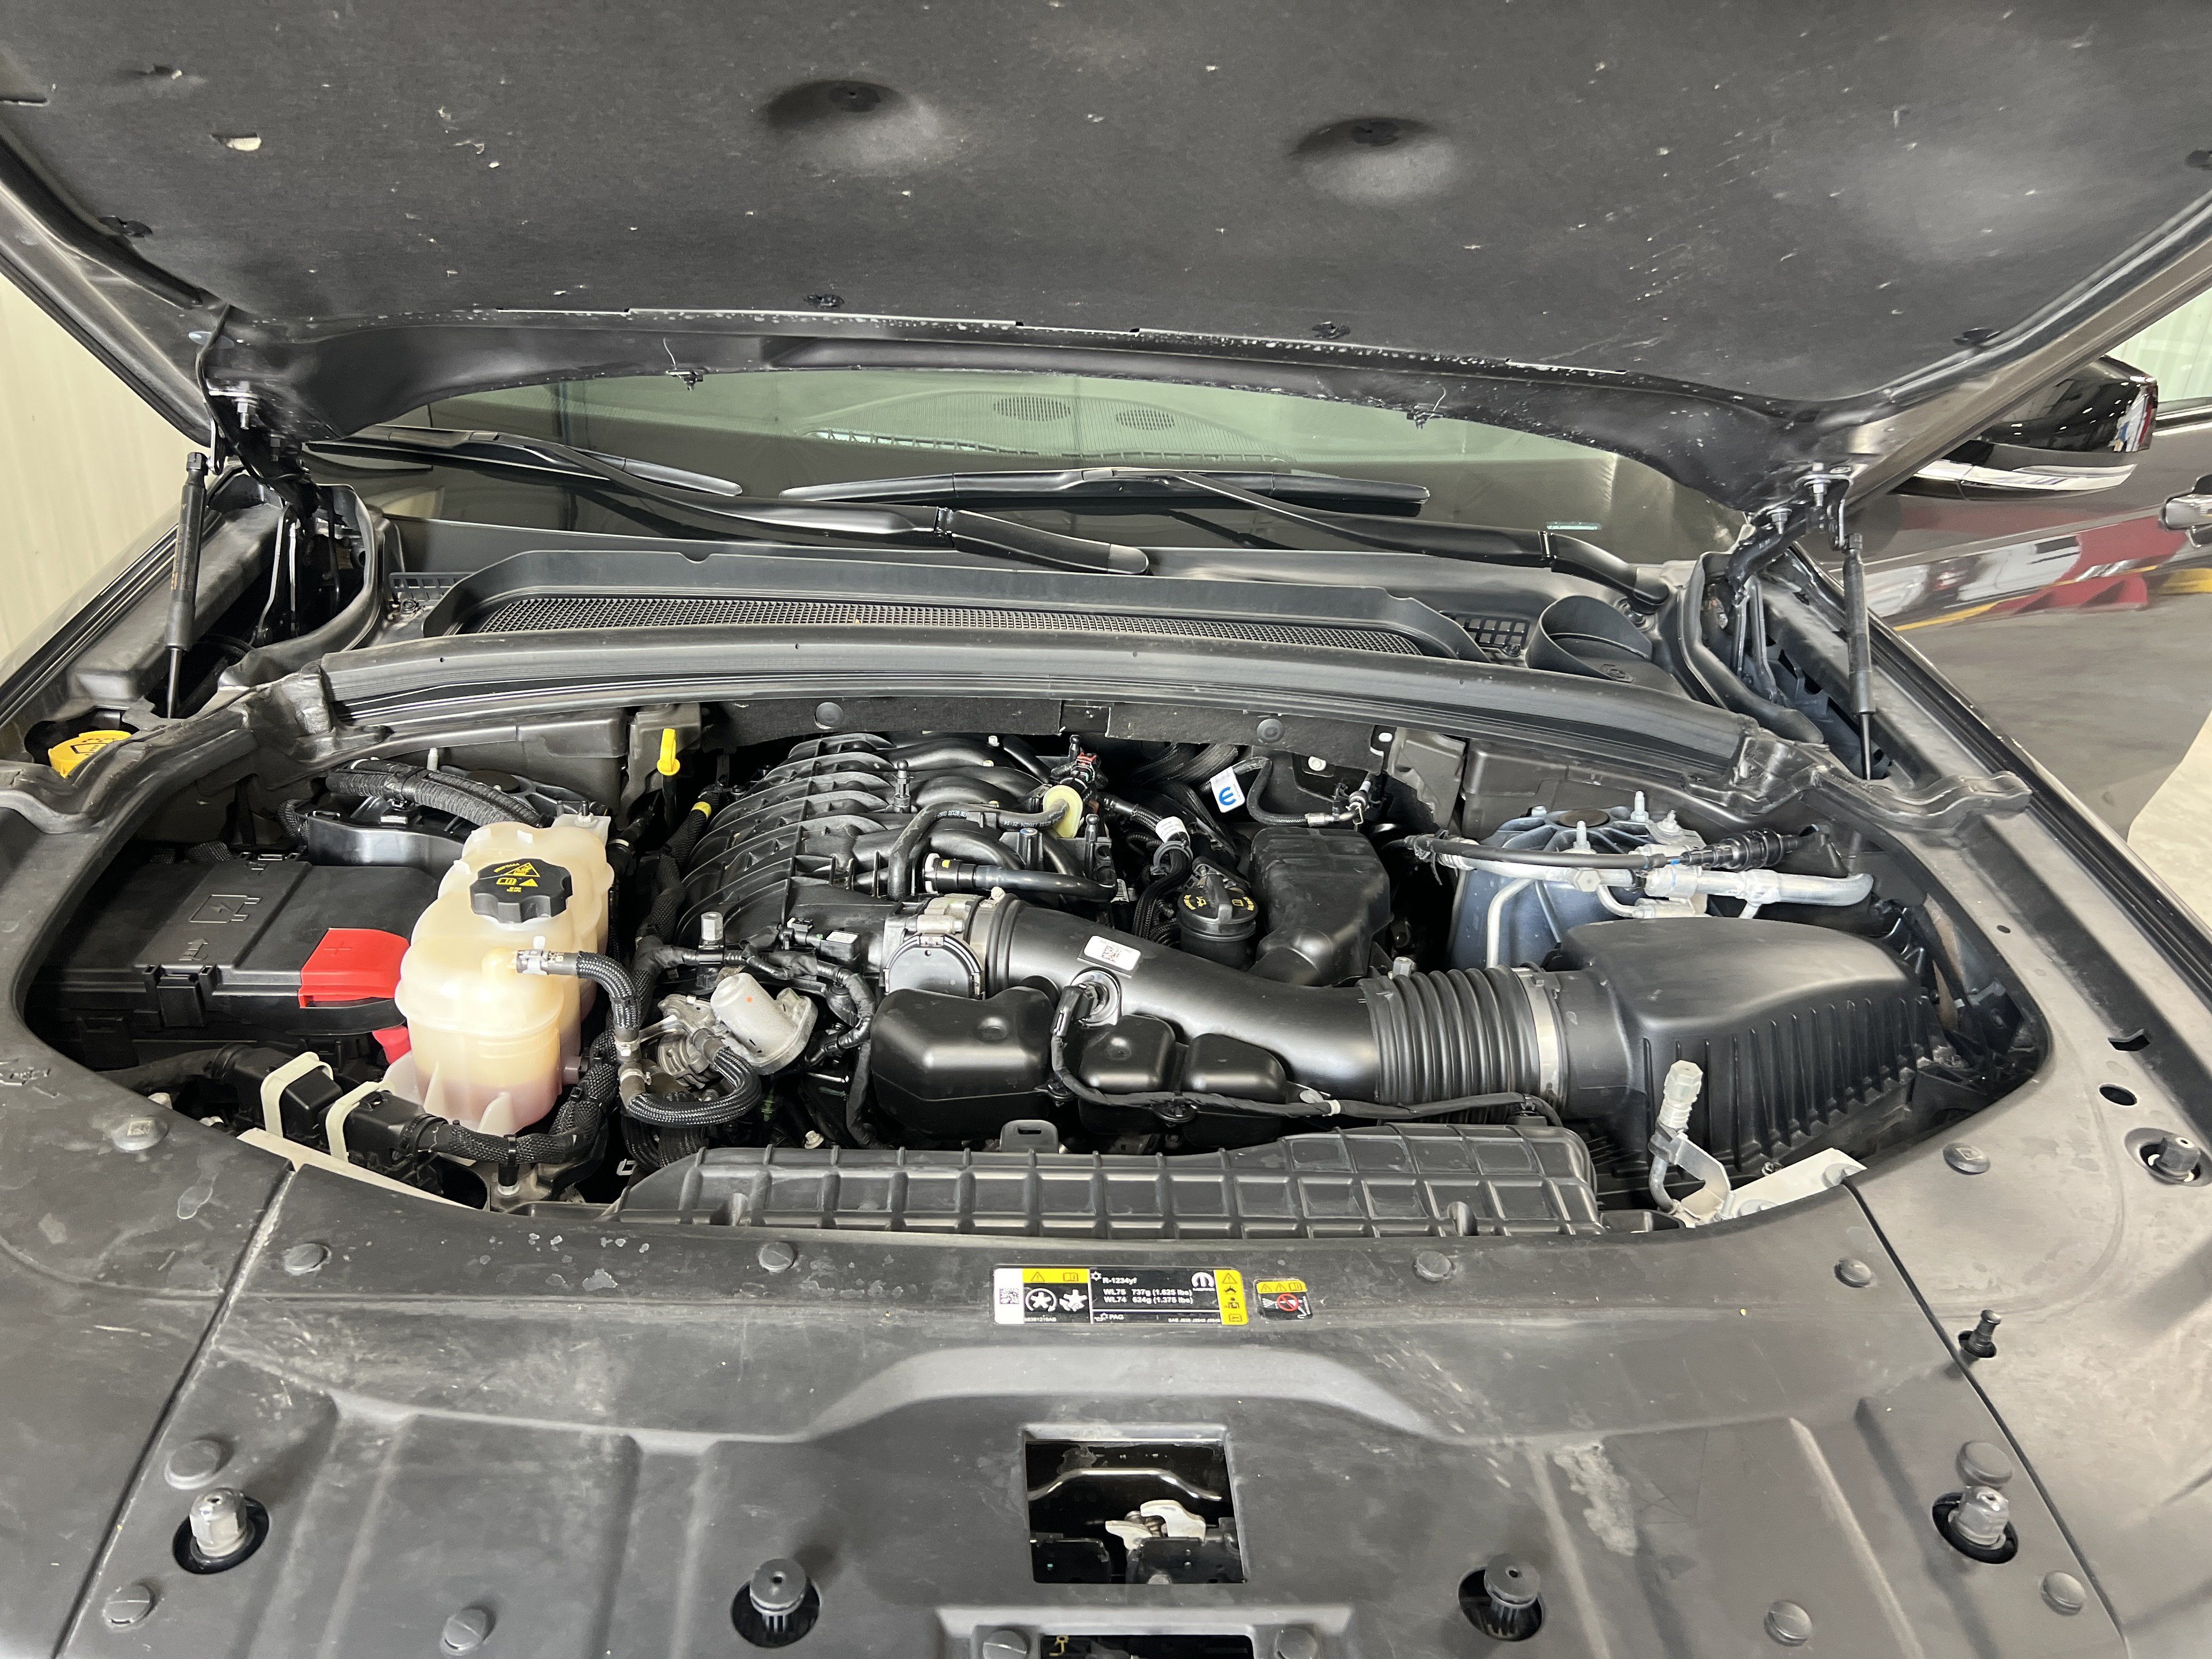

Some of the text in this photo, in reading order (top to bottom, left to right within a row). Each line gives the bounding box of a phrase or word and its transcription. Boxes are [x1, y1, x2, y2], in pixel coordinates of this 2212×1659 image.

[1102, 1277, 1137, 1285] R-1234yf
[1131, 1289, 1152, 1297] 737g
[1152, 1289, 1176, 1297] (1.625
[1177, 1289, 1192, 1297] lbs)
[1132, 1296, 1152, 1305] 624g
[1153, 1296, 1177, 1305] (1.375
[1178, 1296, 1193, 1305] lbs)
